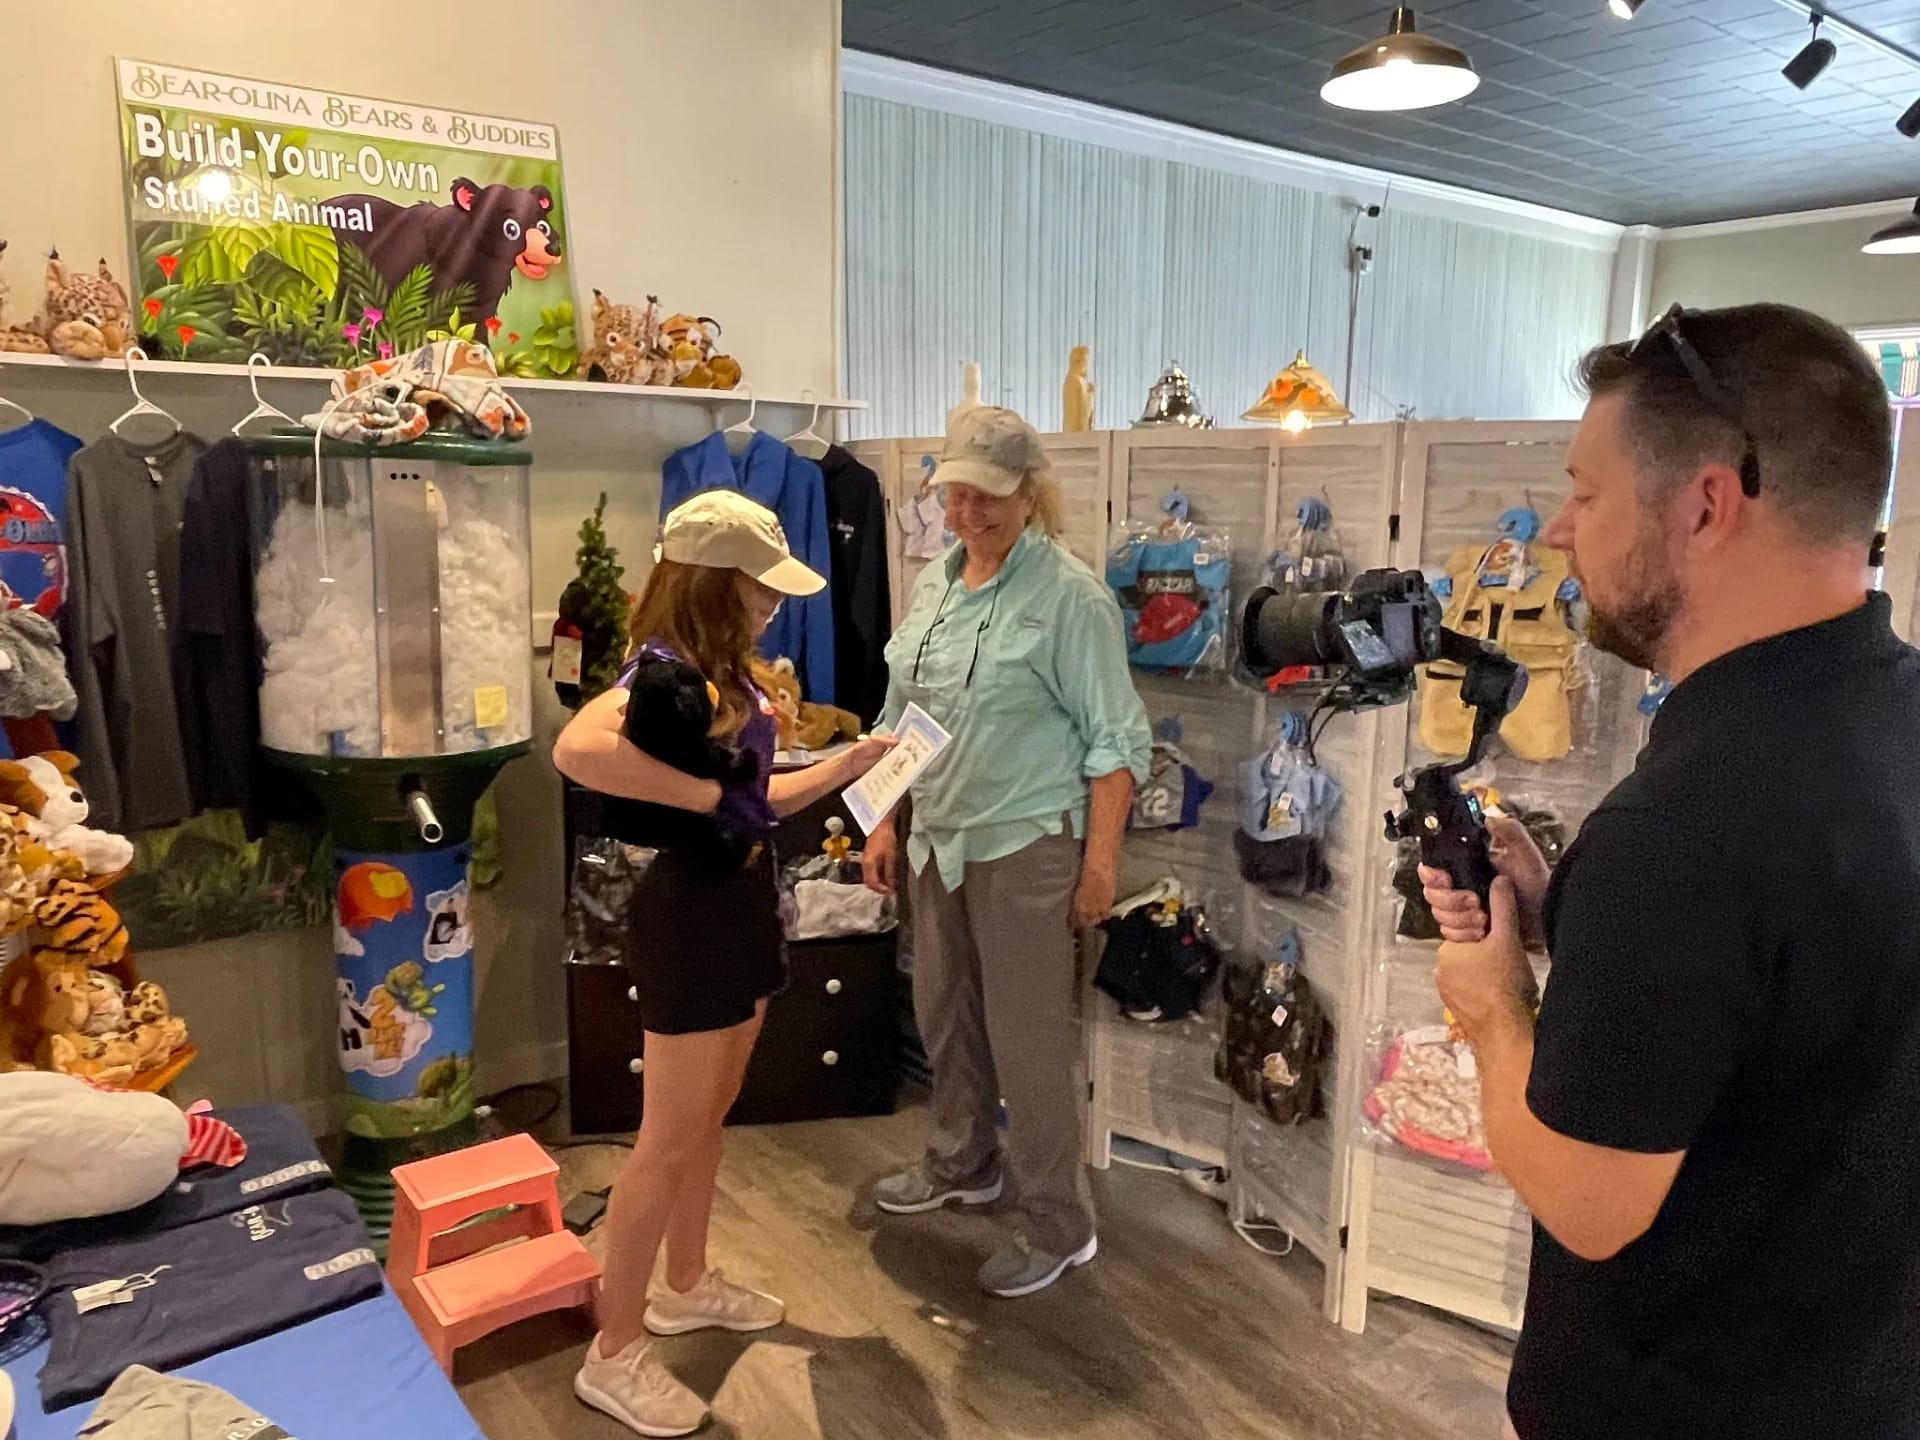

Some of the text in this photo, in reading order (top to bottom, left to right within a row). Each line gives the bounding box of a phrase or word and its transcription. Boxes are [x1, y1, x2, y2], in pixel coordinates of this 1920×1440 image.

[131, 66, 551, 149] BEAR-OLINA BEARS & BUDDIES
[134, 113, 439, 193] Build-Your-Own
[272, 192, 373, 232] Animal
